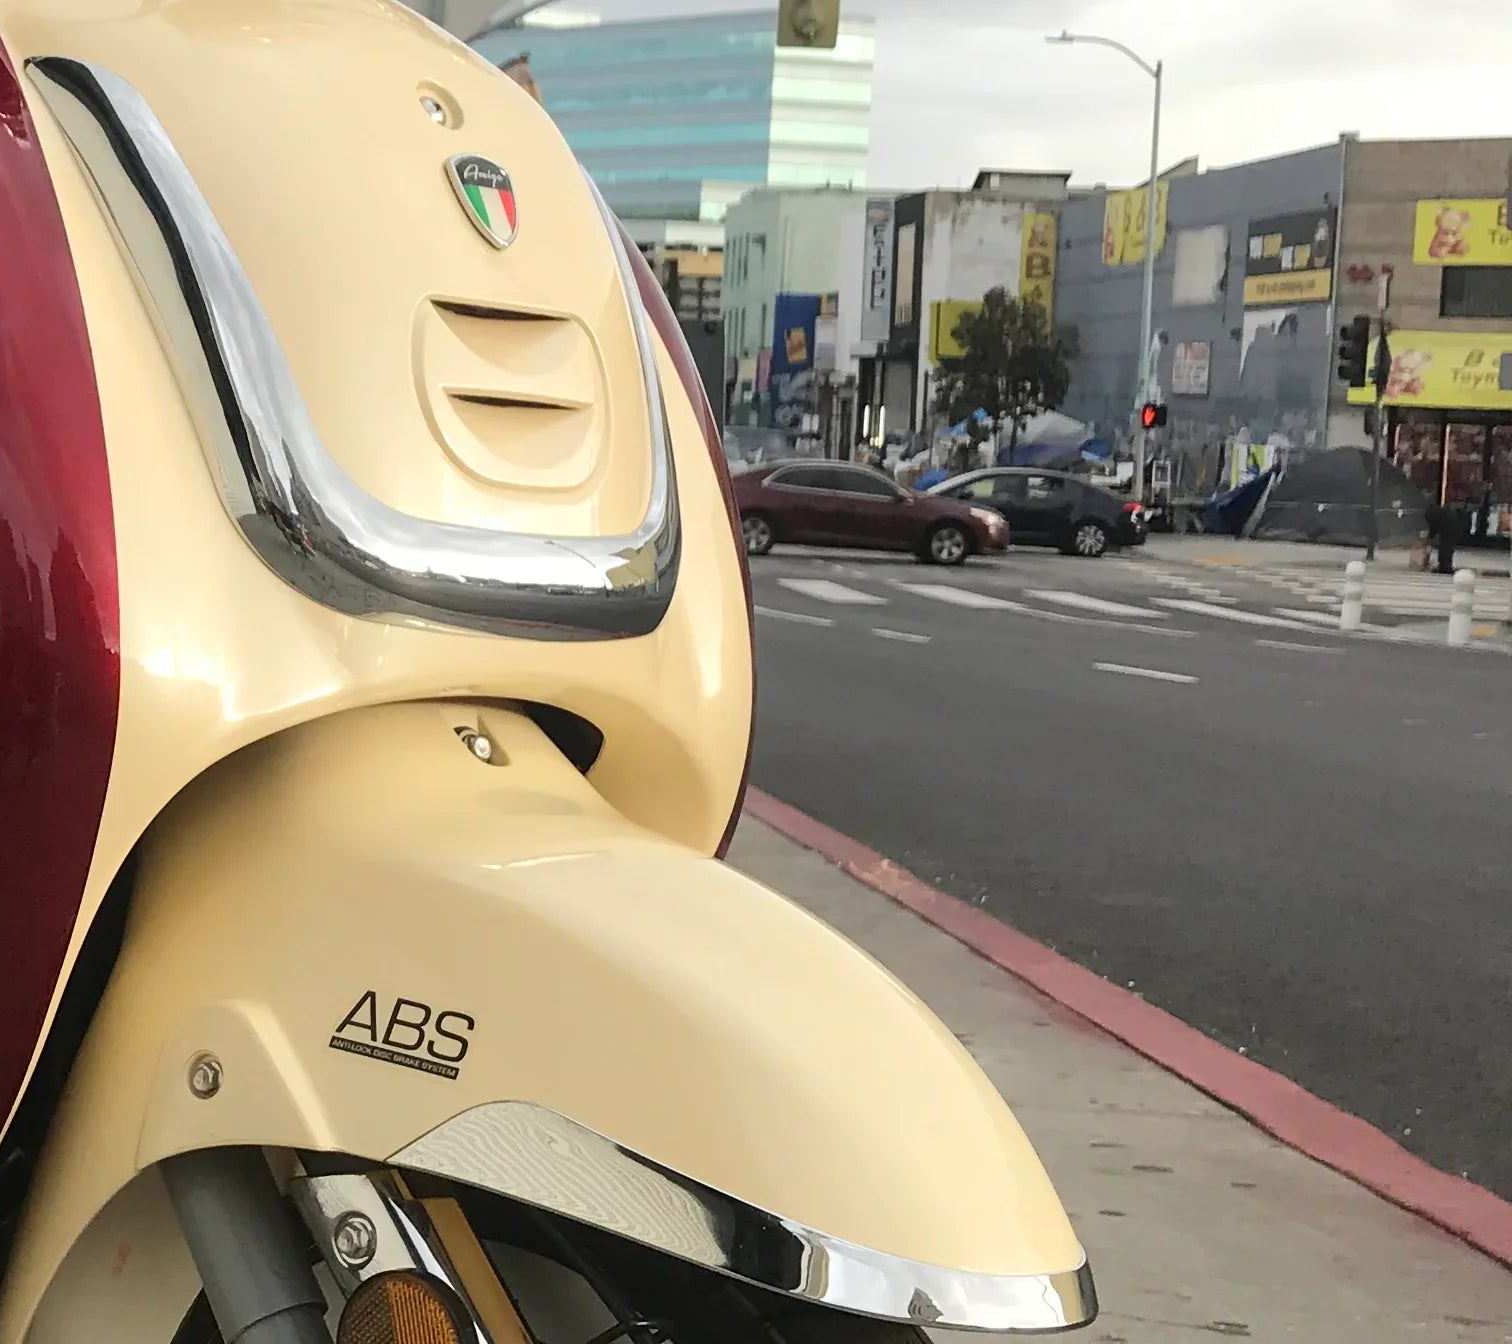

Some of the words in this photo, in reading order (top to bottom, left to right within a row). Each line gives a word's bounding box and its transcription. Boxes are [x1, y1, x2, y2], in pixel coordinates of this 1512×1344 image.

[335, 990, 475, 1063] ABS
[392, 1054, 420, 1067] BRAKE
[421, 1062, 457, 1077] SYSTEM
